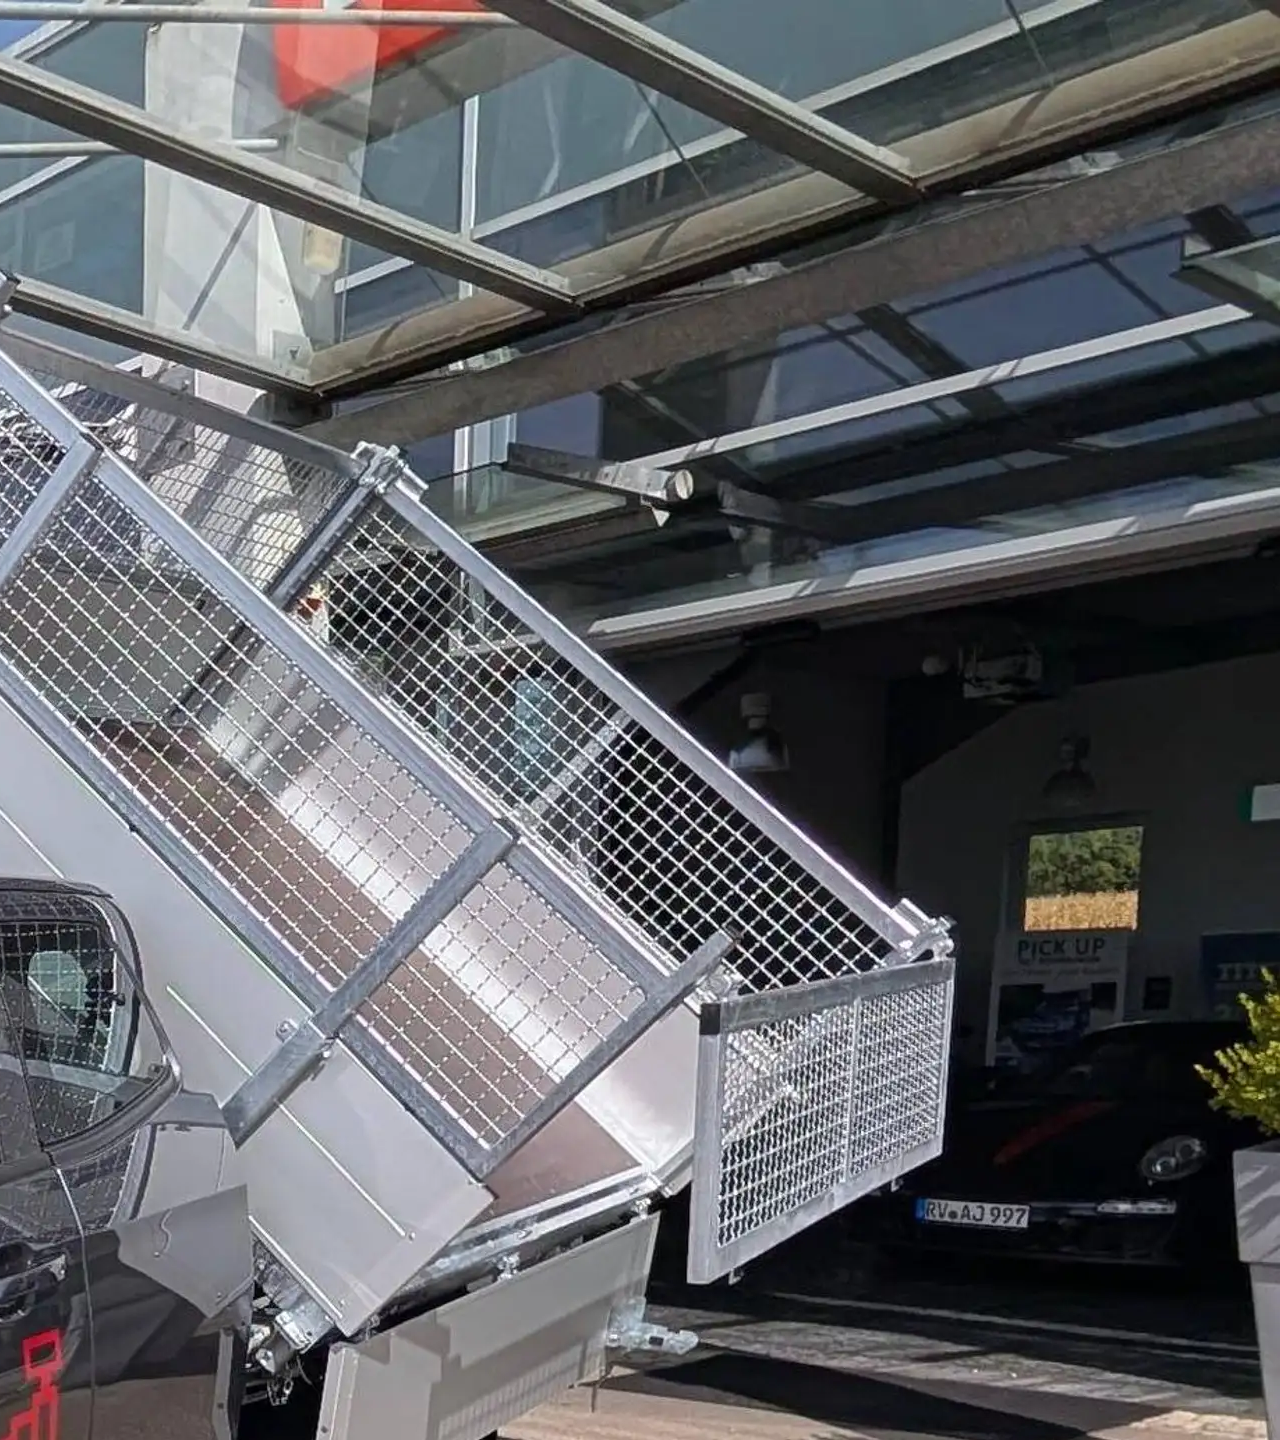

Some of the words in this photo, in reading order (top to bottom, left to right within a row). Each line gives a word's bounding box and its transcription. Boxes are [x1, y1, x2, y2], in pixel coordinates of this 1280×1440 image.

[1018, 938, 1065, 959] PICK
[1075, 937, 1106, 956] UP
[926, 1201, 948, 1219] RV
[960, 1204, 986, 1222] AJ
[989, 1206, 1027, 1226] 997
